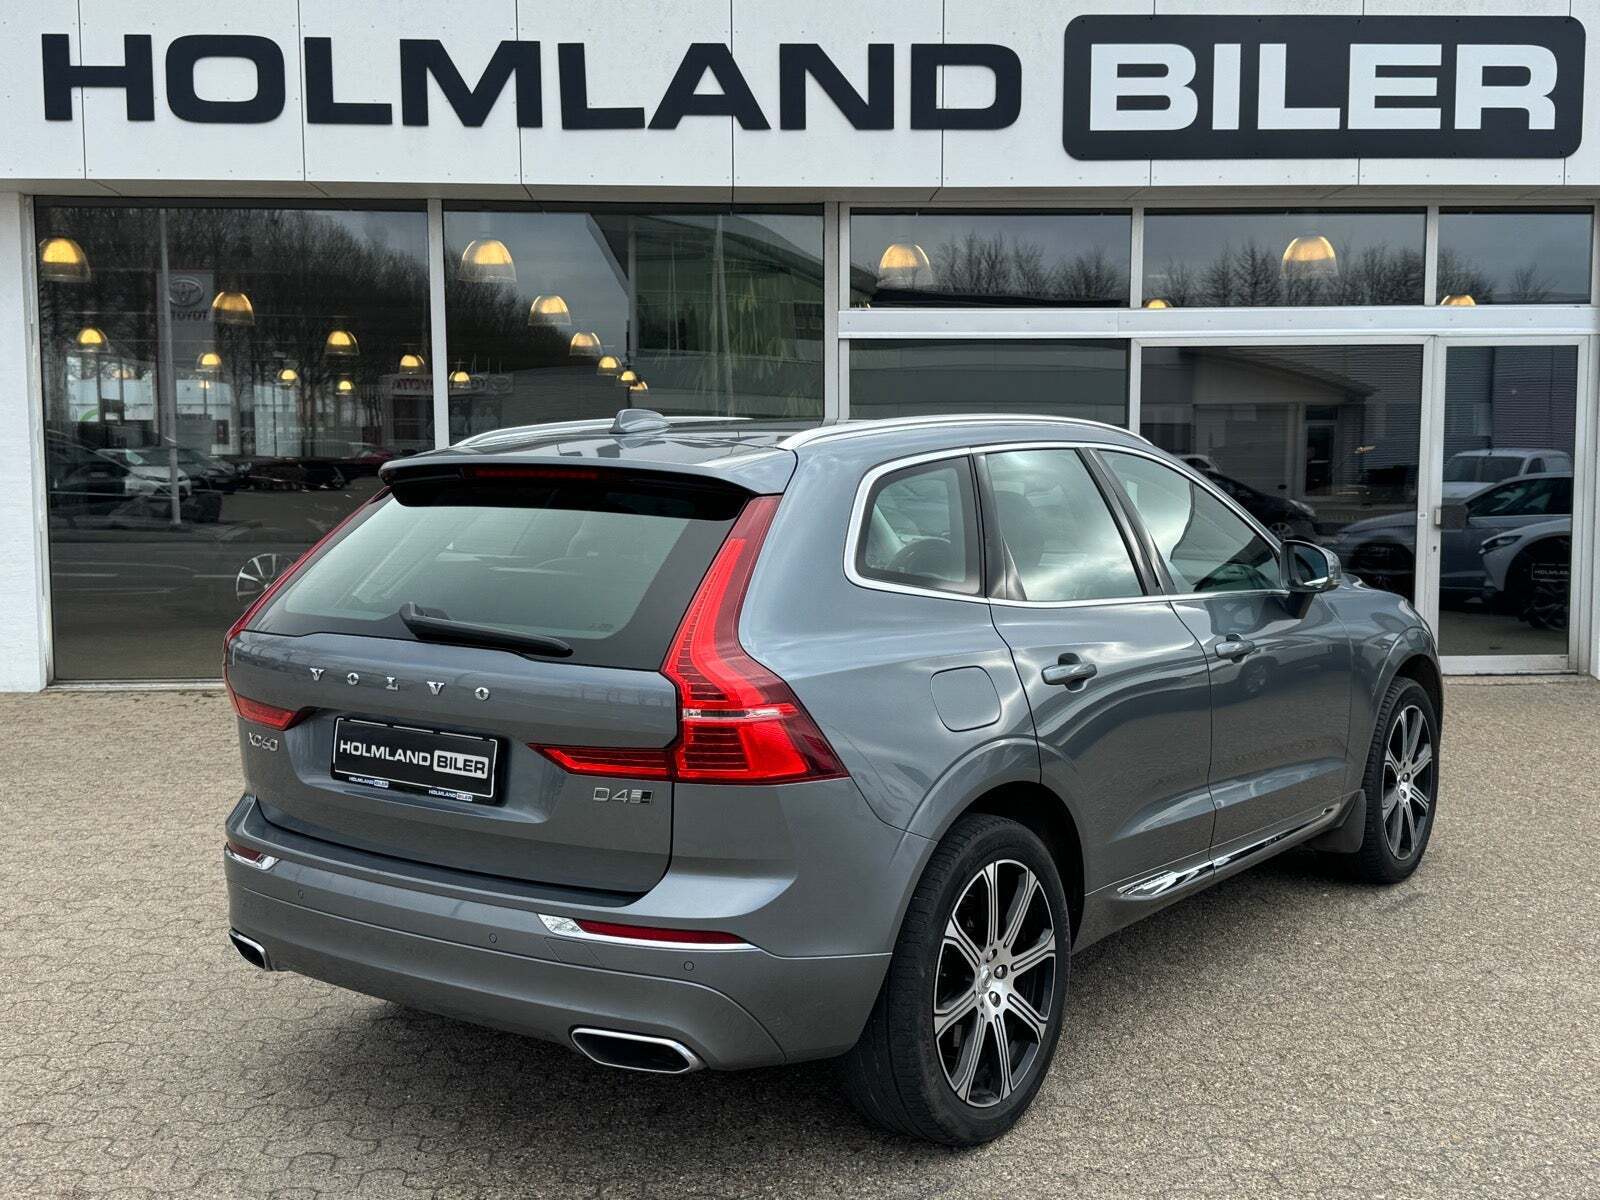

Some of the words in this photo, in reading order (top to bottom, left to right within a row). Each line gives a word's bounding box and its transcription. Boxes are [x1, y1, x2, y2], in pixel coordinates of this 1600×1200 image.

[41, 33, 1022, 131] HOLMLAND
[1090, 43, 1558, 131] BILER
[310, 667, 490, 701] VOLVO
[248, 731, 279, 752] XC60
[339, 739, 431, 766] HOLMLAND
[436, 754, 486, 775] BILER
[348, 776, 374, 785] HOLMLAND
[429, 789, 456, 798] HOLMLAND
[593, 787, 629, 803] D4
